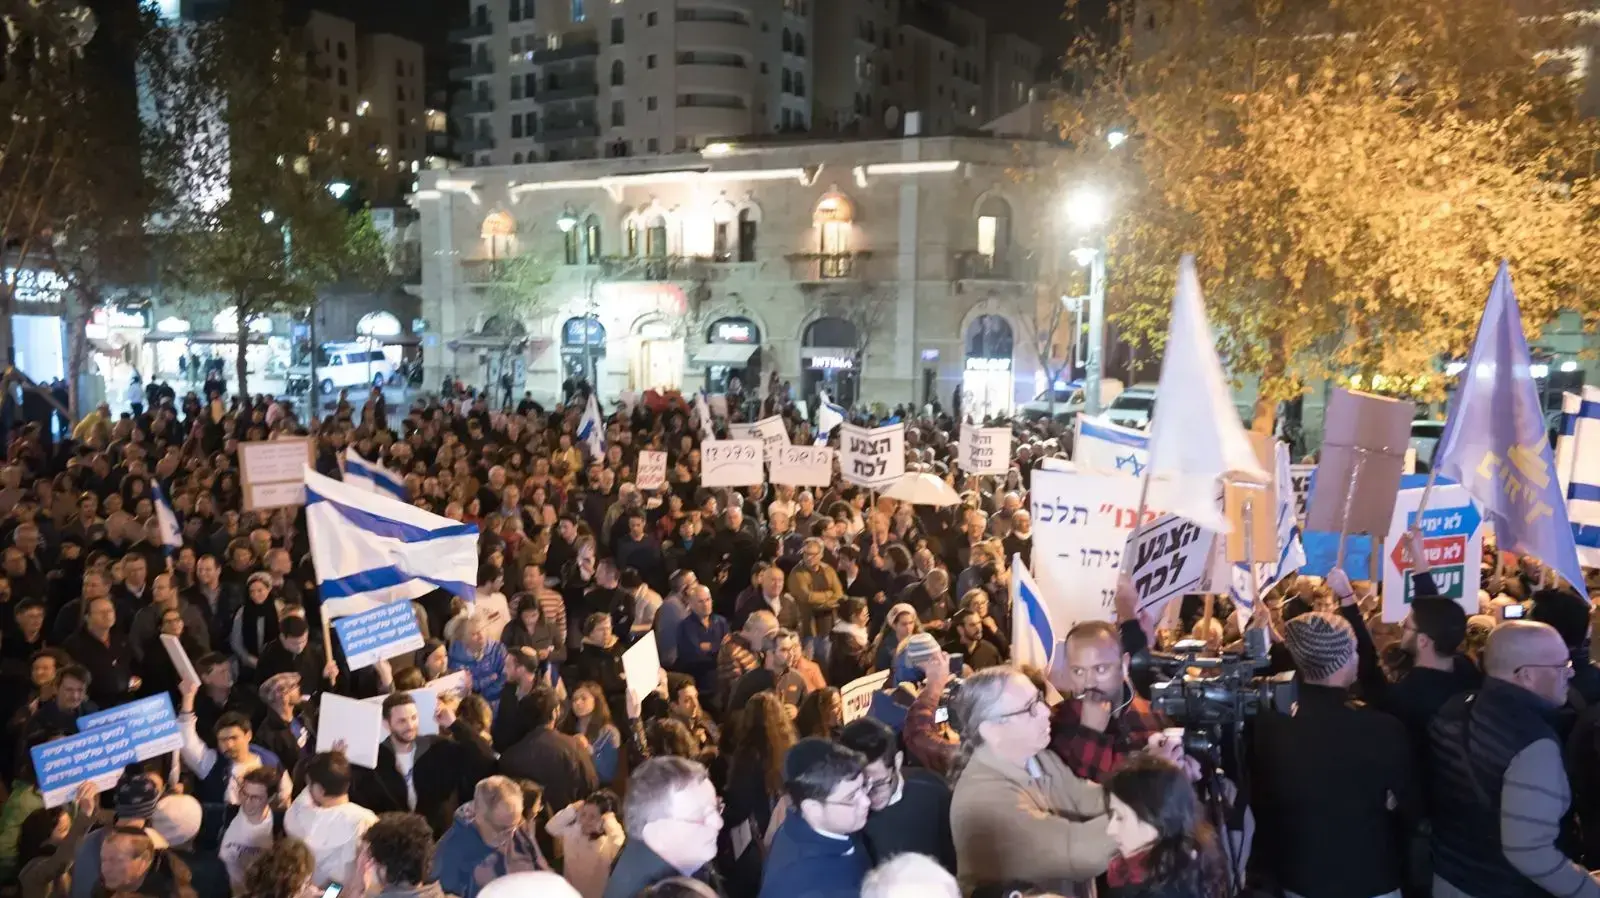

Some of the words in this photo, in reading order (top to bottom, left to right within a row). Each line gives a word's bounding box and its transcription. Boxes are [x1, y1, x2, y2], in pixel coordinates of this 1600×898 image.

[1031, 496, 1089, 526] תלכו
[1443, 513, 1462, 530] לא
[1442, 542, 1461, 560] לא
